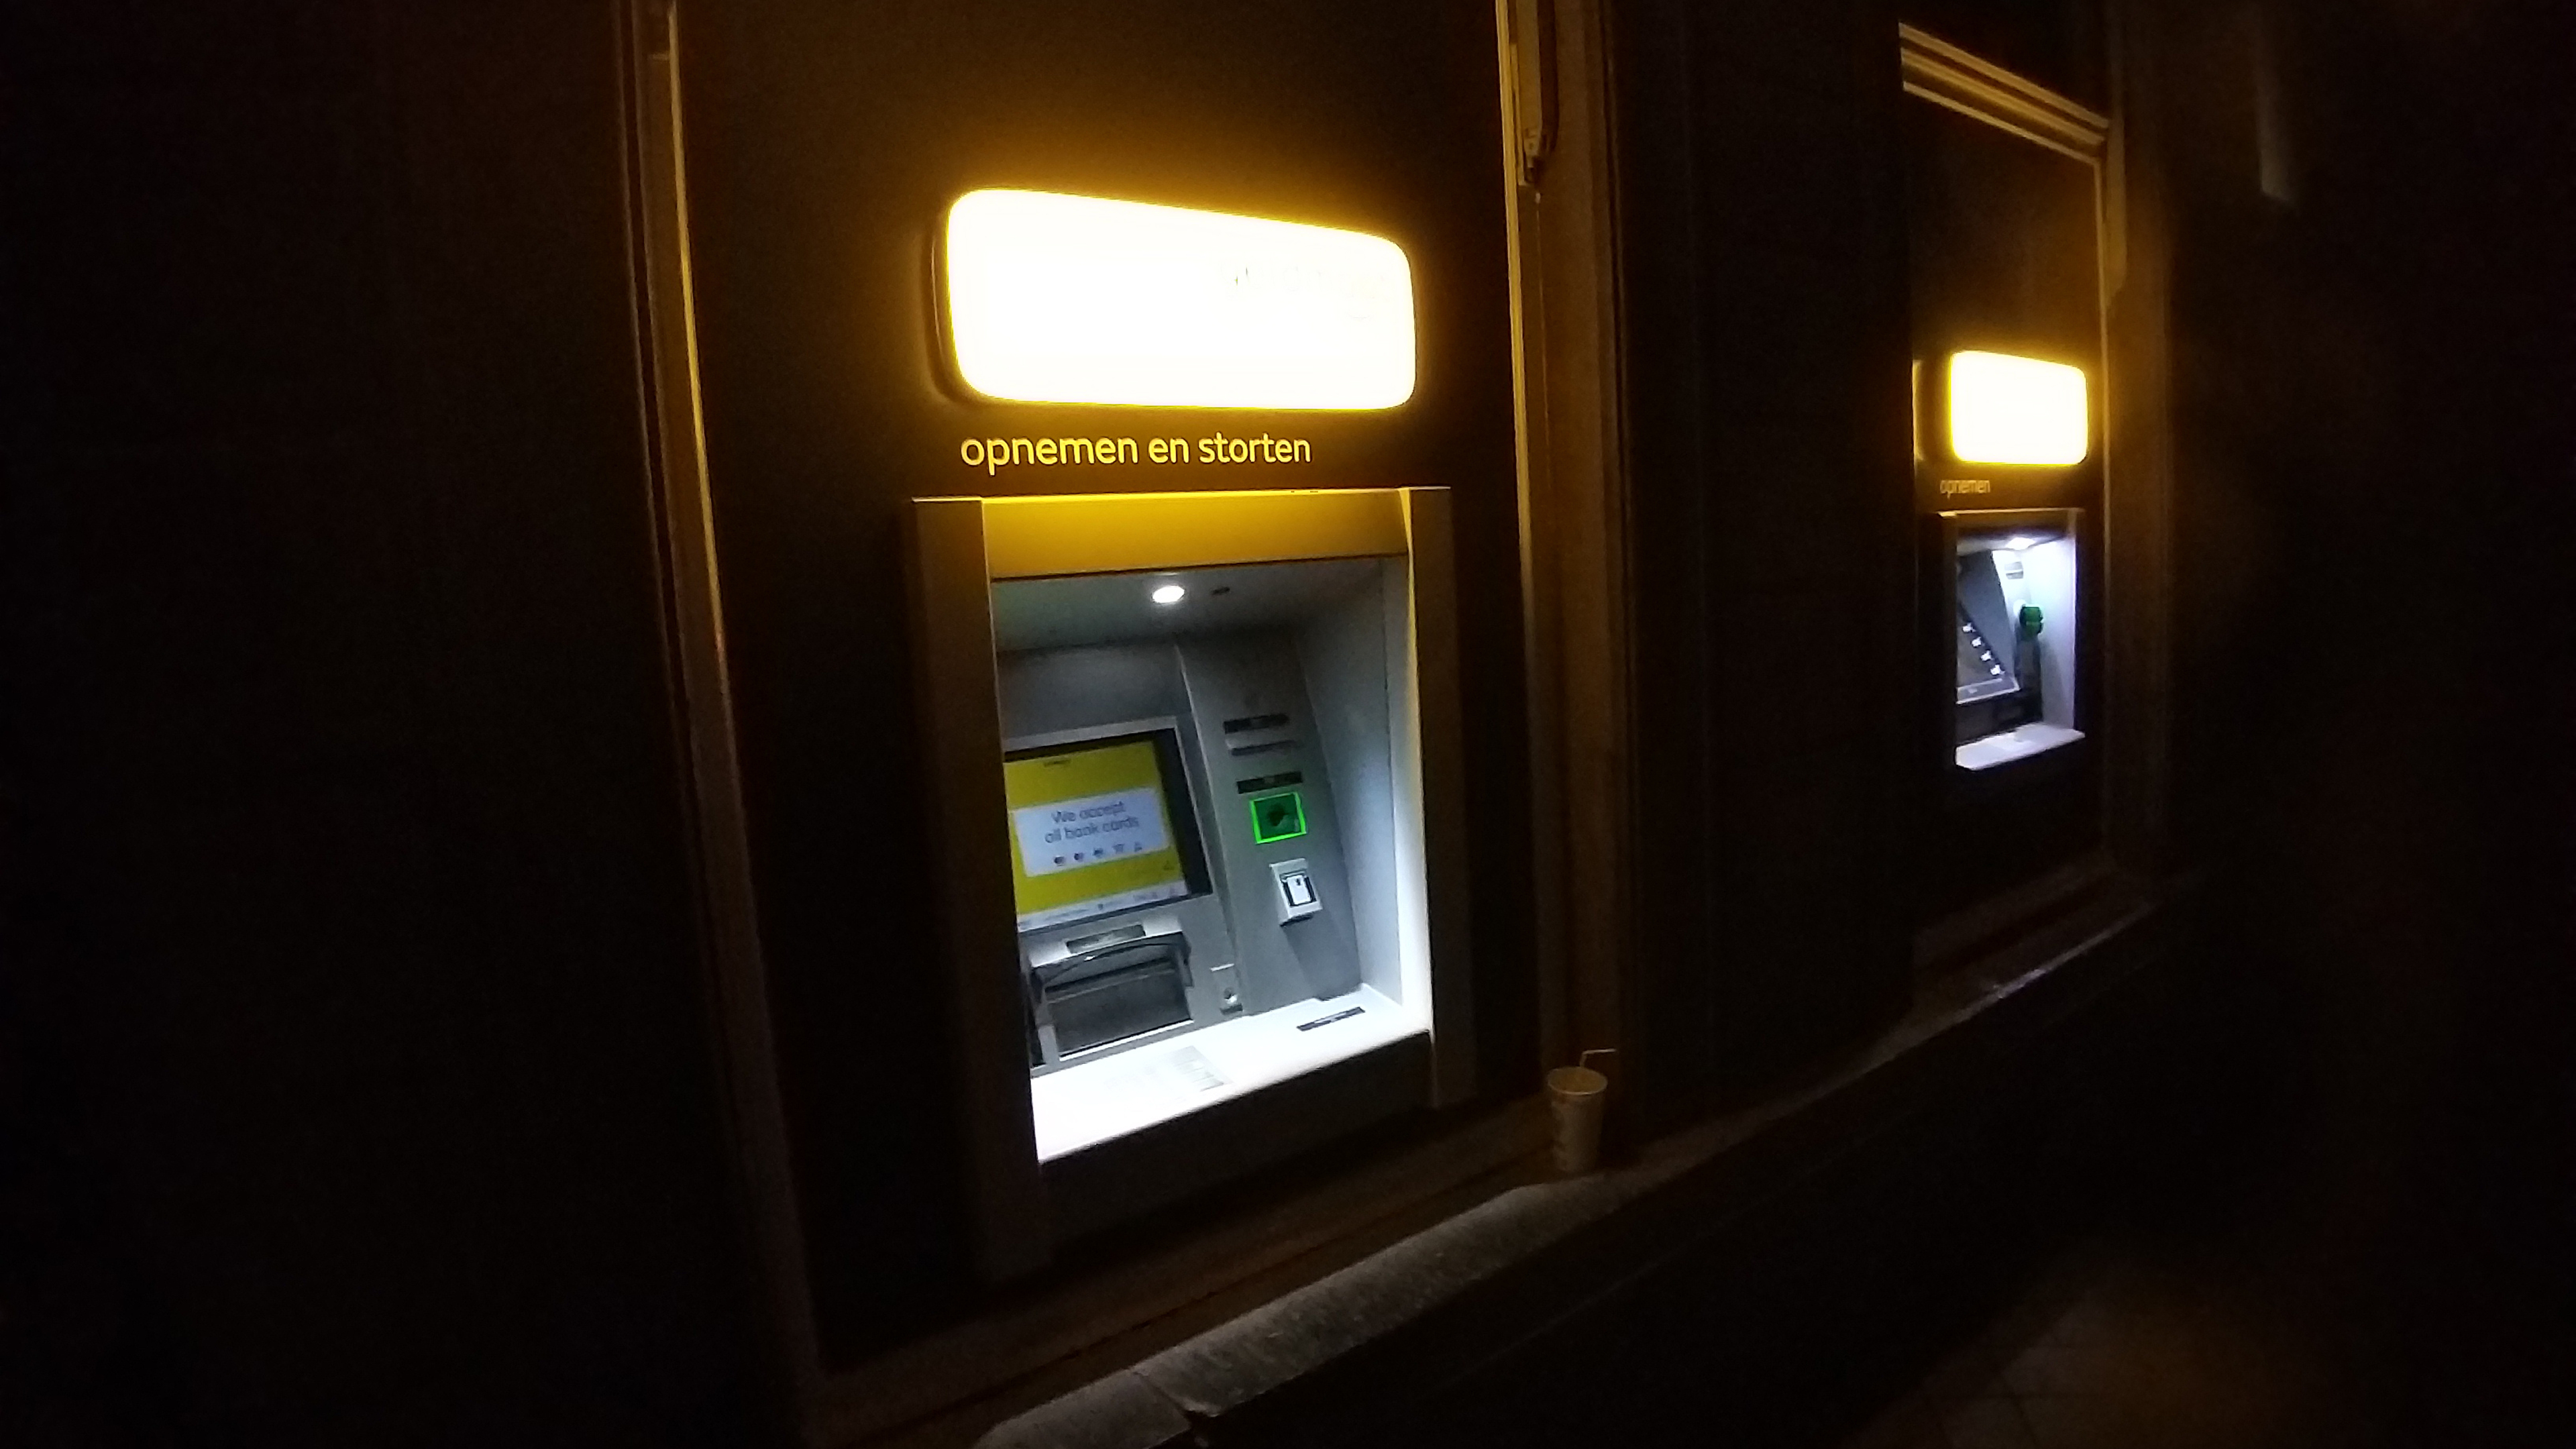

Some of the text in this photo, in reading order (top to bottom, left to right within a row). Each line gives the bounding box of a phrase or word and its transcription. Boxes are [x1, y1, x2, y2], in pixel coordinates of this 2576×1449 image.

[960, 431, 1311, 476] opnemen en storten
[1051, 800, 1126, 824] We accept
